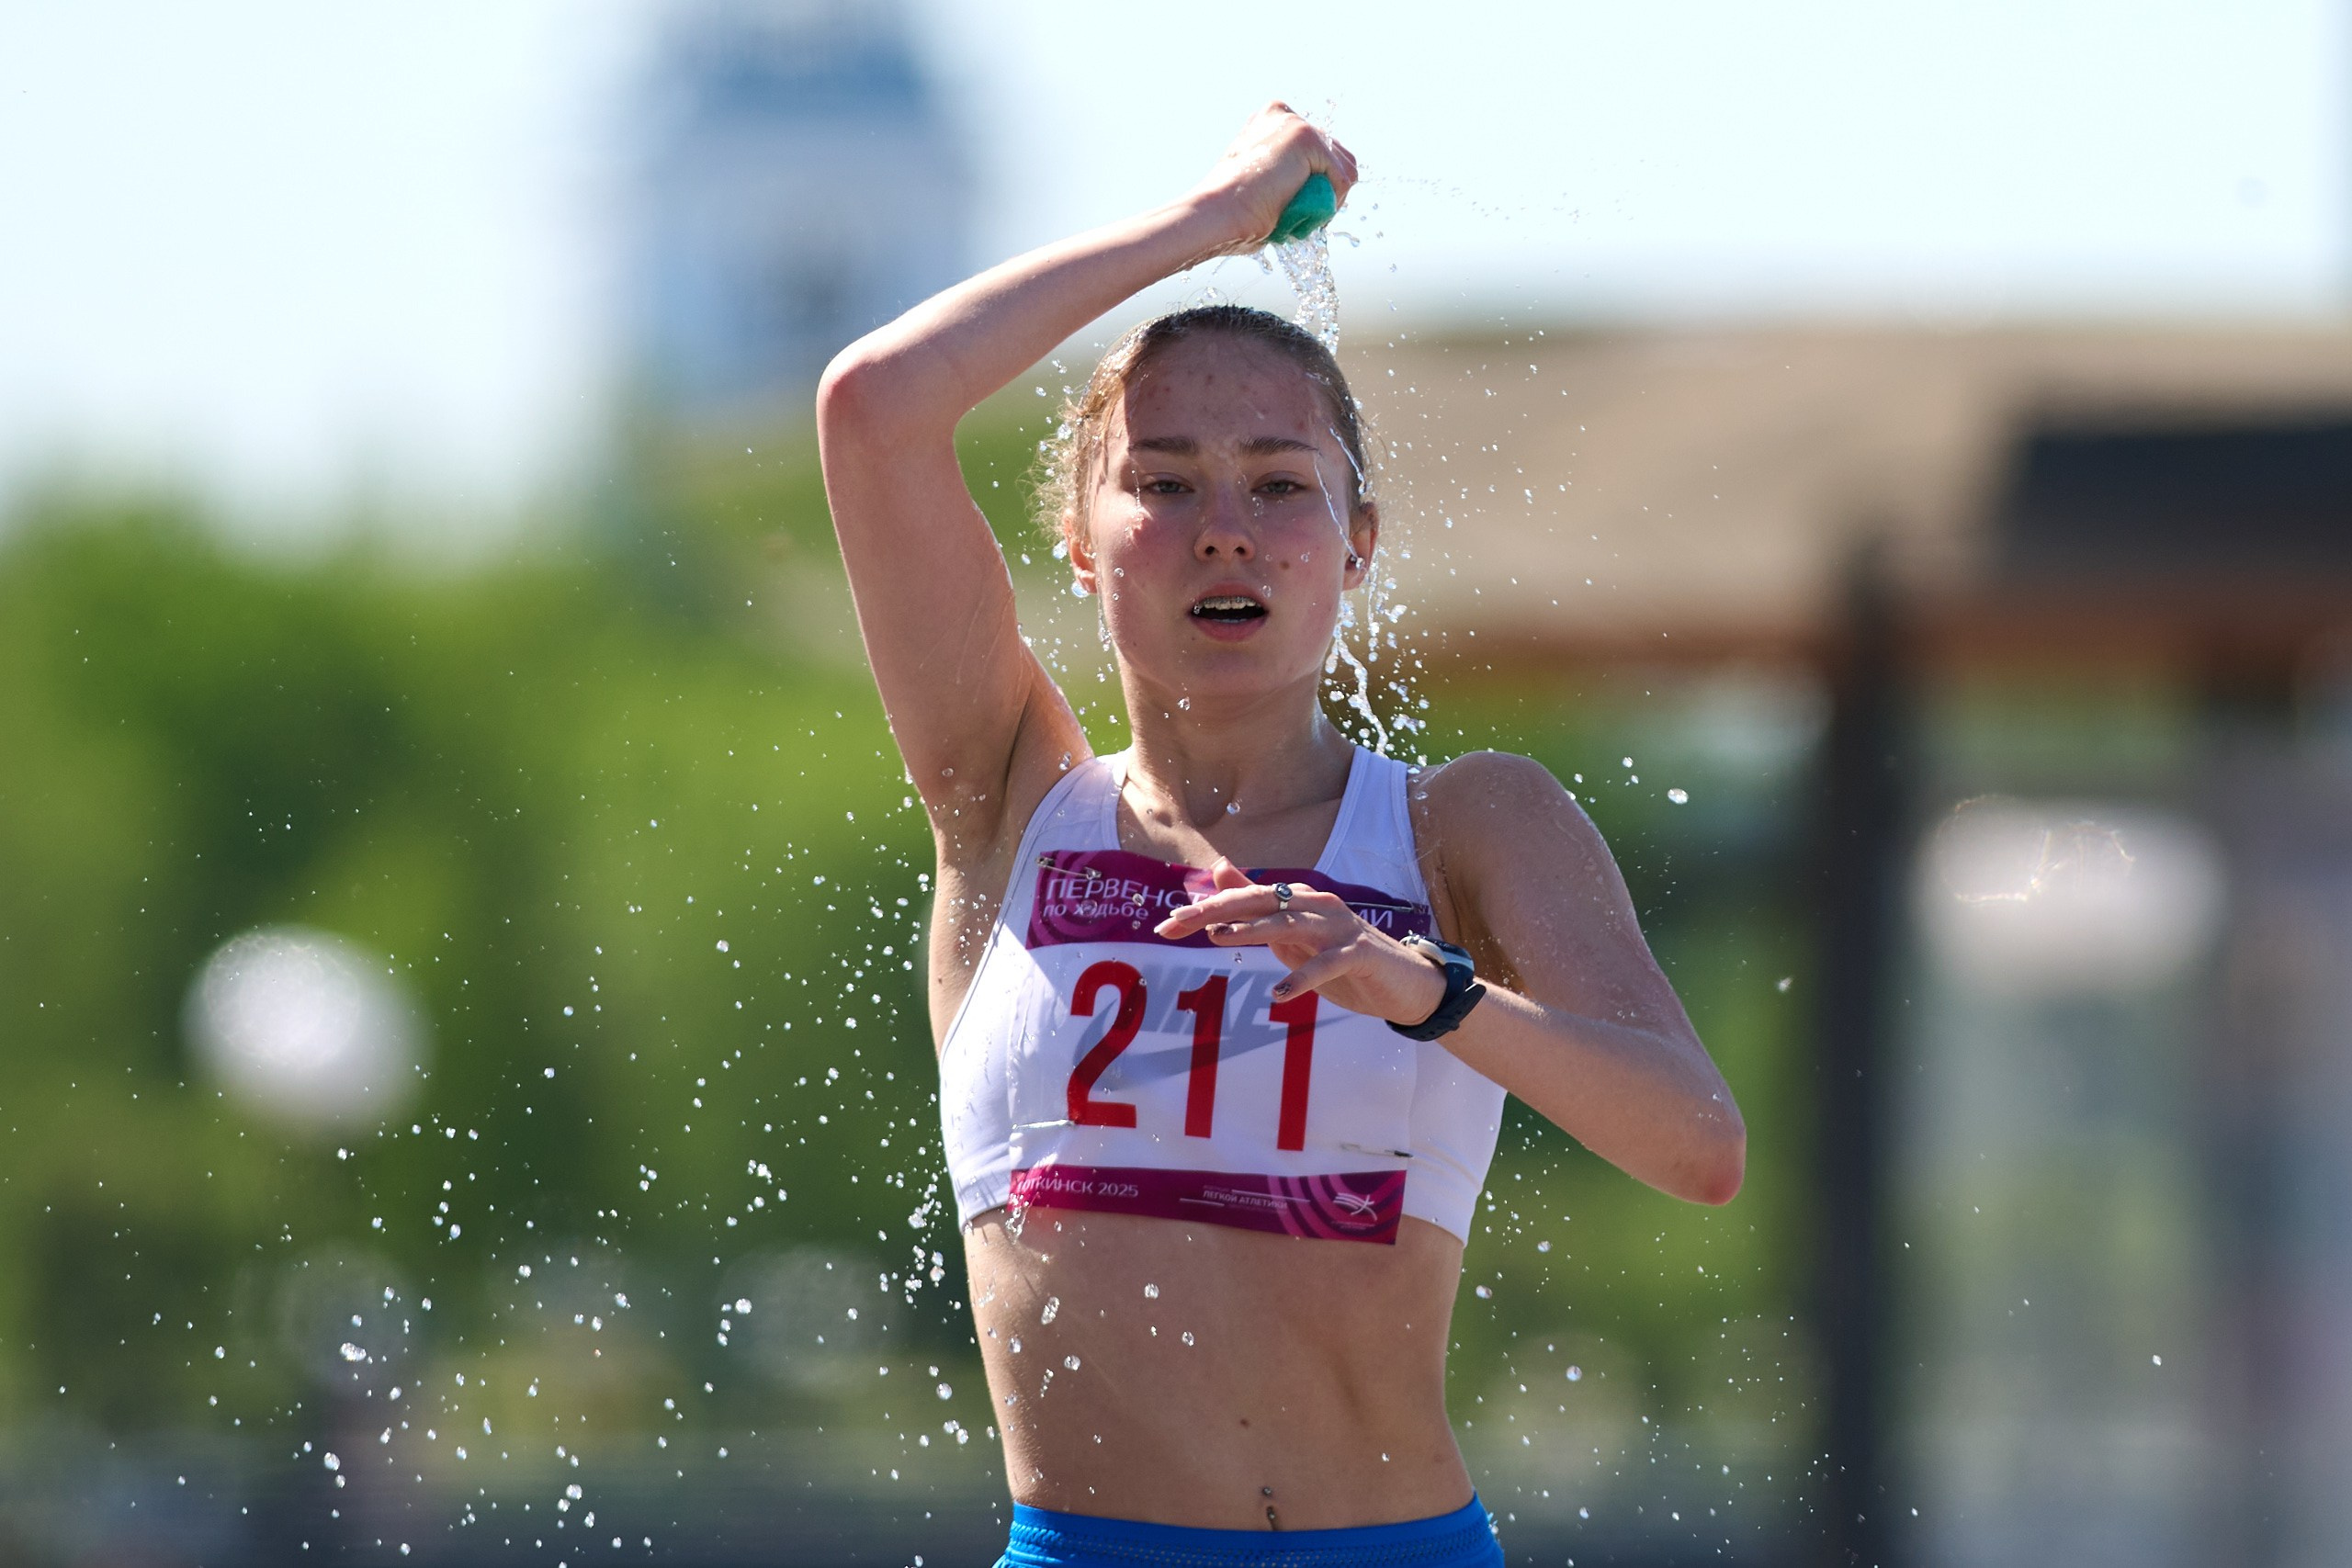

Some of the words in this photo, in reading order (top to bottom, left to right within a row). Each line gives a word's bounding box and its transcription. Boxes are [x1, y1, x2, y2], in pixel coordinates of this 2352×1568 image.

[1046, 878, 1211, 908] ПЕРВЕНСТ
[1043, 903, 1068, 918] по
[1072, 901, 1149, 920] ходьбе
[1067, 960, 1319, 1152] 211
[1098, 1181, 1139, 1198] 2025
